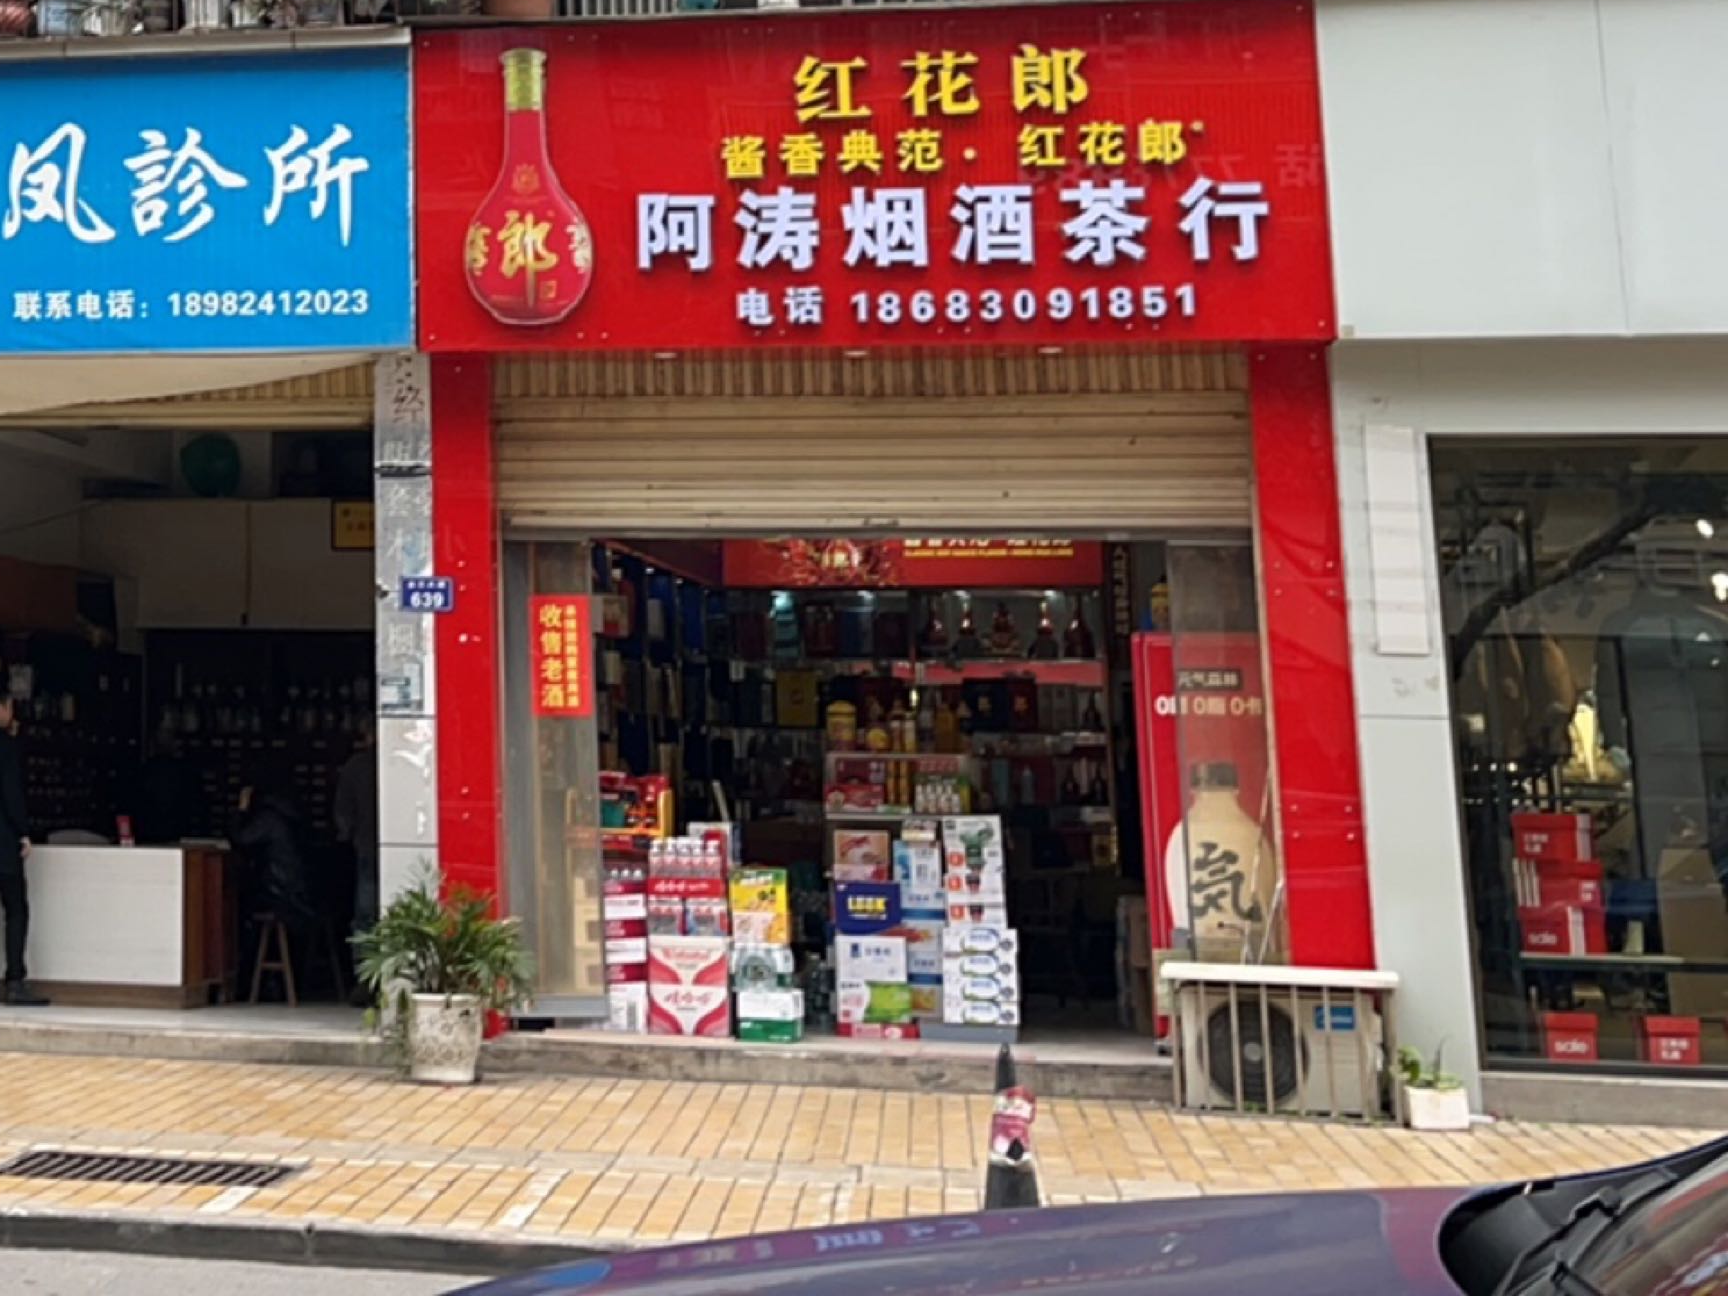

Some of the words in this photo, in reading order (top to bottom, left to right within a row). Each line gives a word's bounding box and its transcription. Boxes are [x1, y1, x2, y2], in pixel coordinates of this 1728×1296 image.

[795, 42, 1089, 124] 红花郎
[636, 176, 1270, 272] 阿涛烟酒茶行
